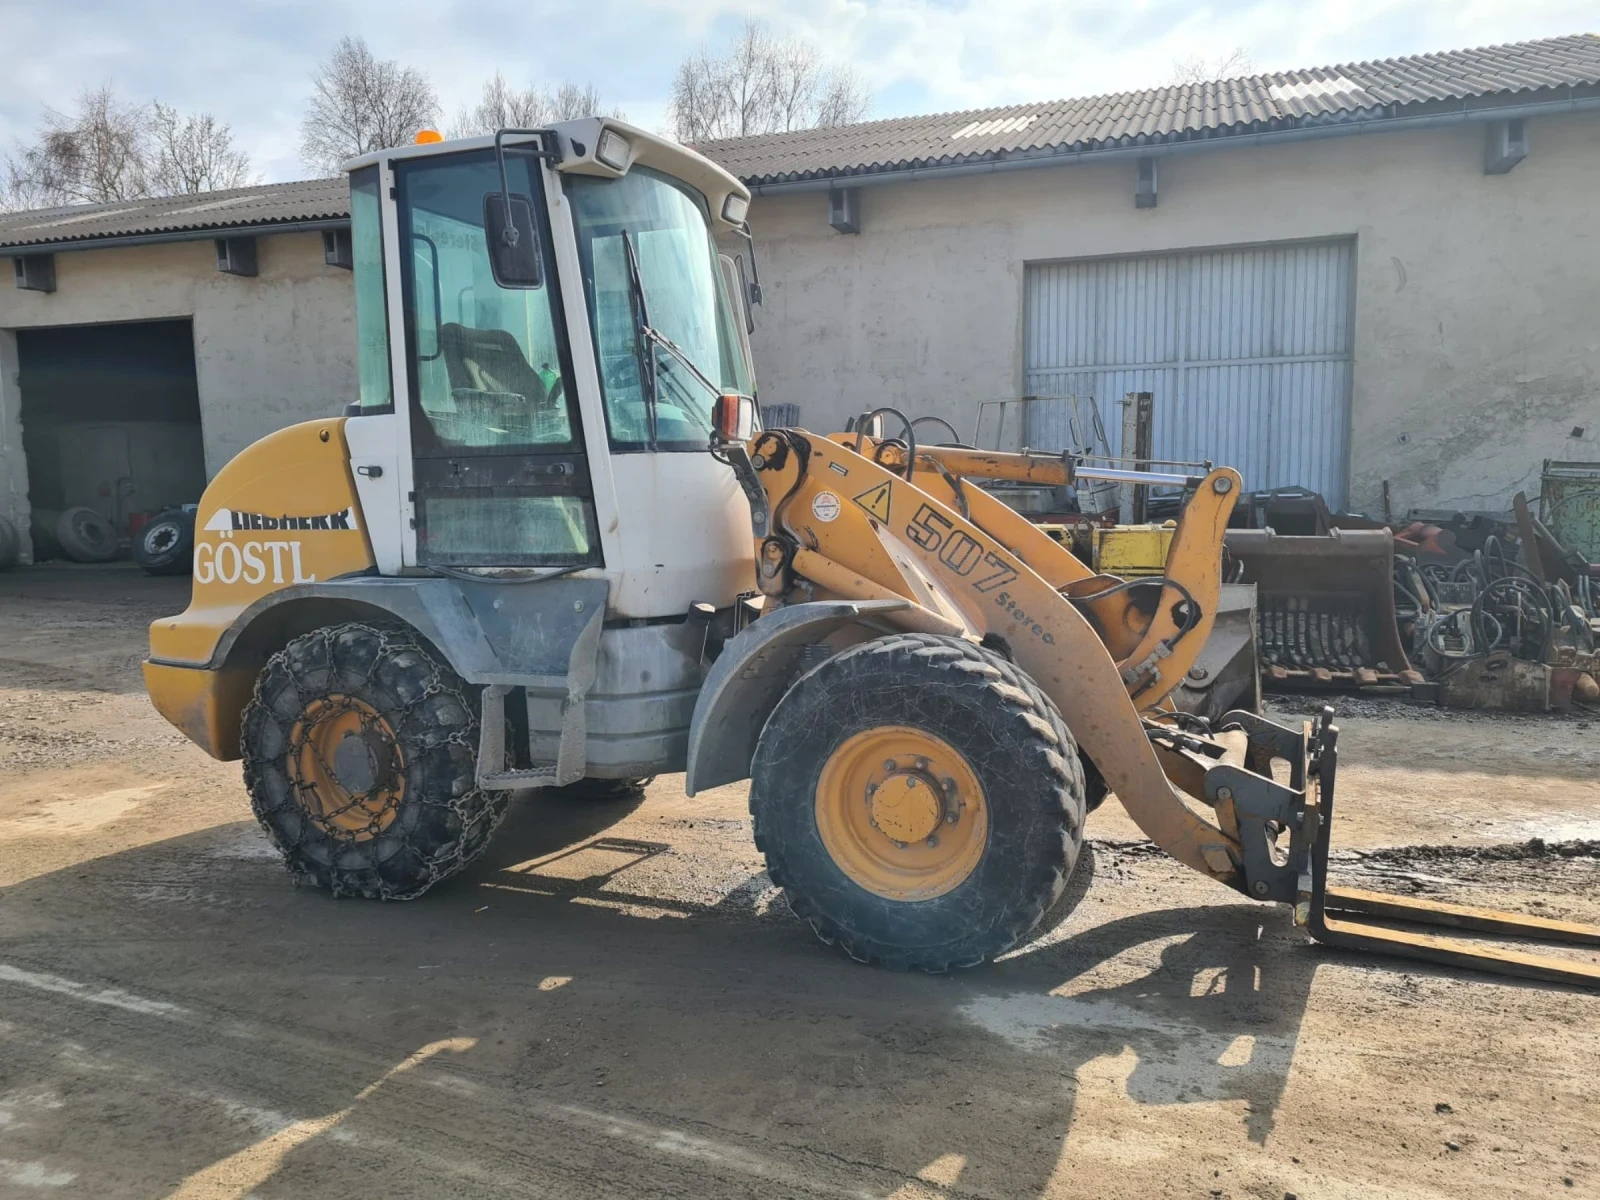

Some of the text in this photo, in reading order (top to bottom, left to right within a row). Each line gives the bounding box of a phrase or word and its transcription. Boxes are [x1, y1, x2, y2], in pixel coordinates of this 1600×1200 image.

[193, 531, 316, 585] GÖSTL
[906, 503, 1020, 593] 507
[995, 592, 1054, 645] Stereo
